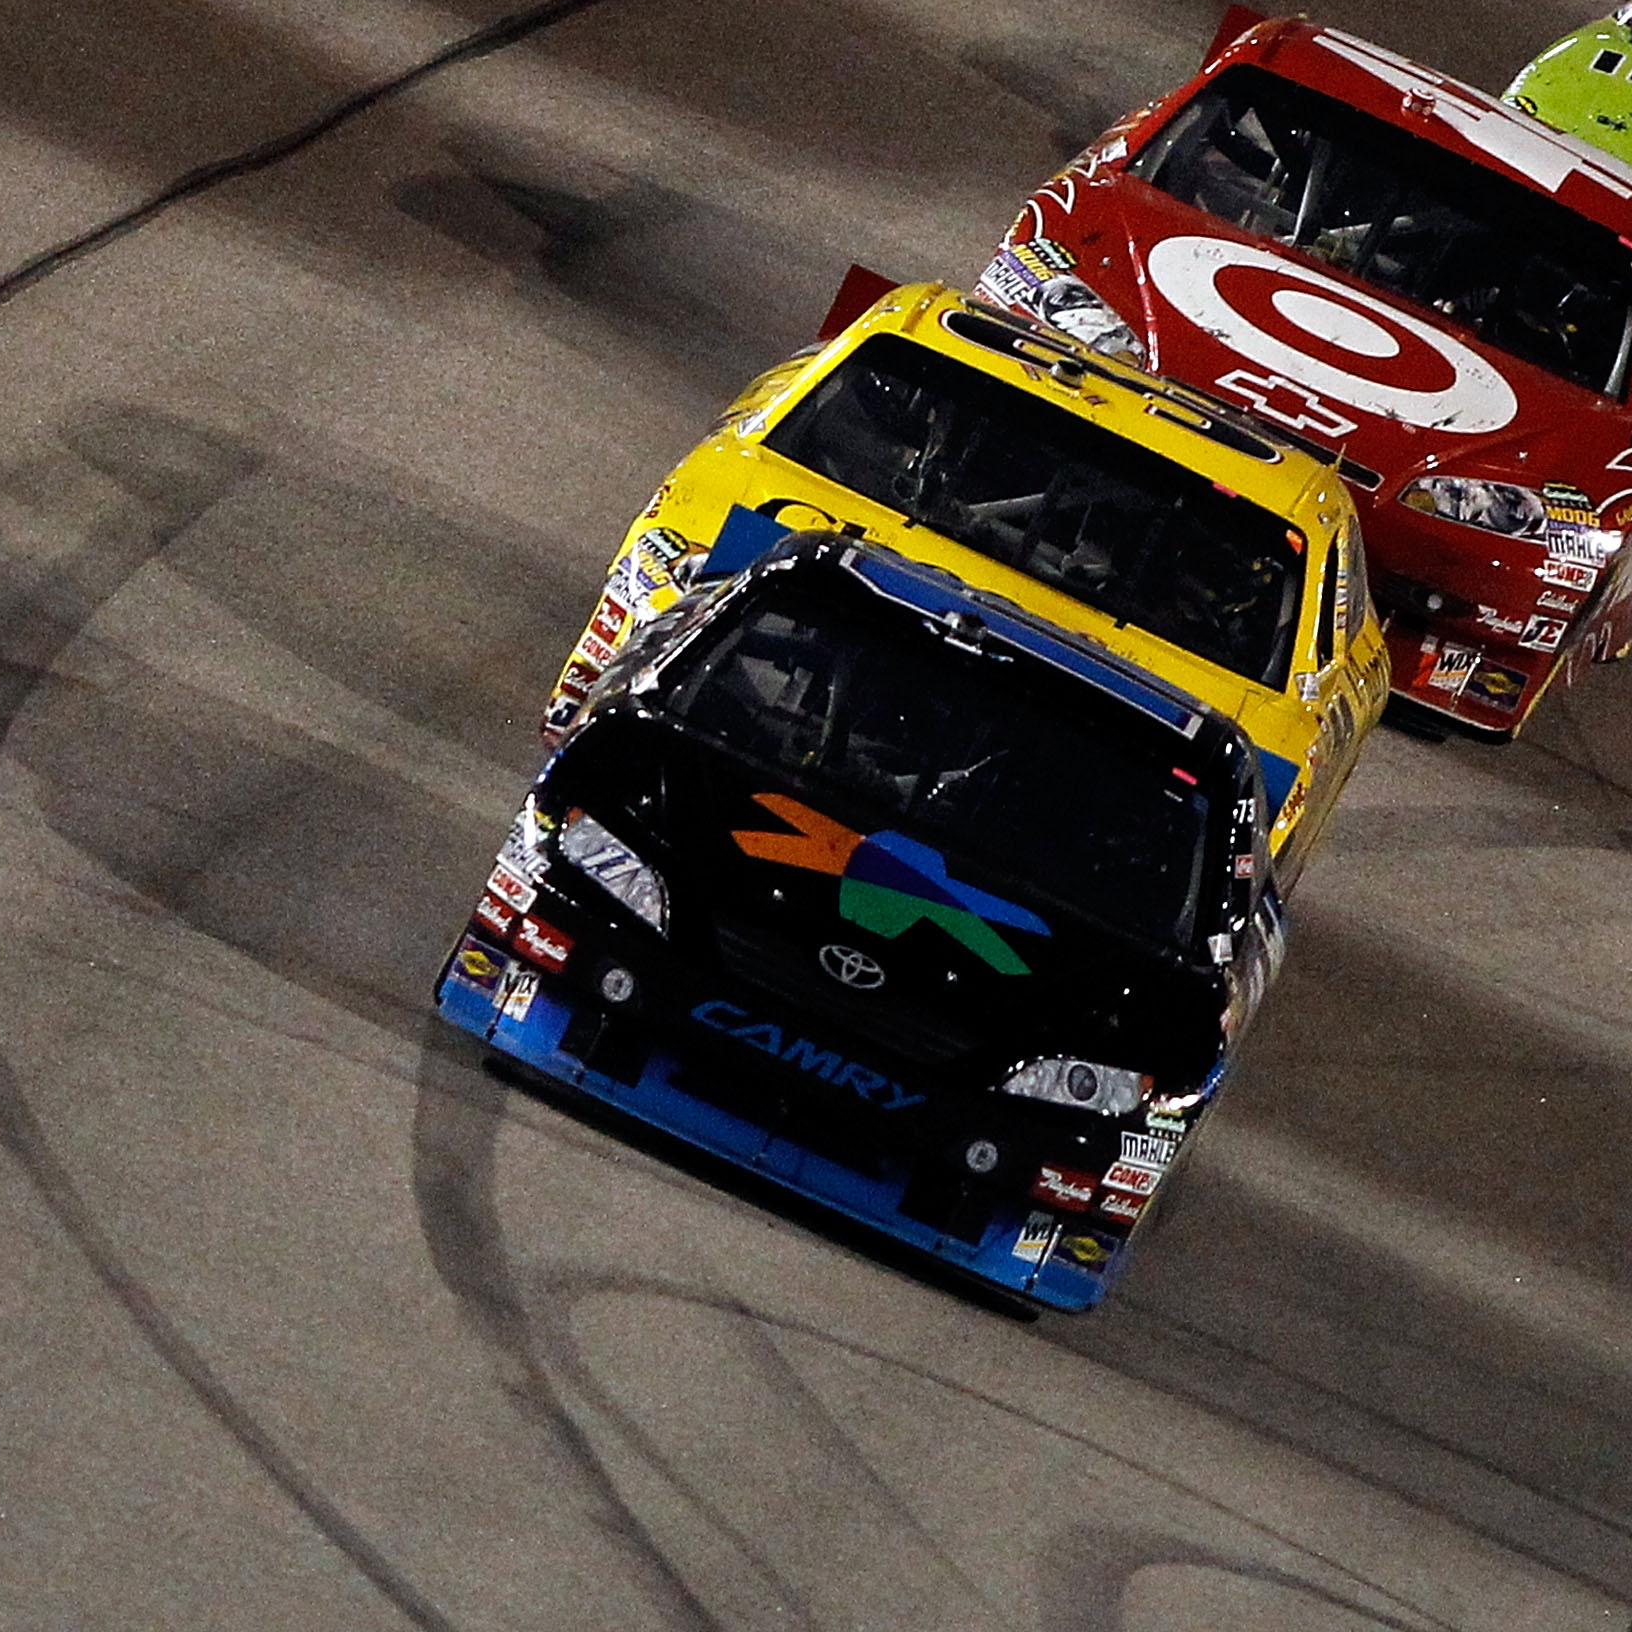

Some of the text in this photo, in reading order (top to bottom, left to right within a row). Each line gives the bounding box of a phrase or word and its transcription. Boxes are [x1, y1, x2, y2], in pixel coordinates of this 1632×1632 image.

[985, 258, 1028, 303] MAHLE
[1012, 244, 1054, 280] MOOG
[1547, 506, 1600, 527] MOOG
[691, 1001, 927, 1109] CAMRY
